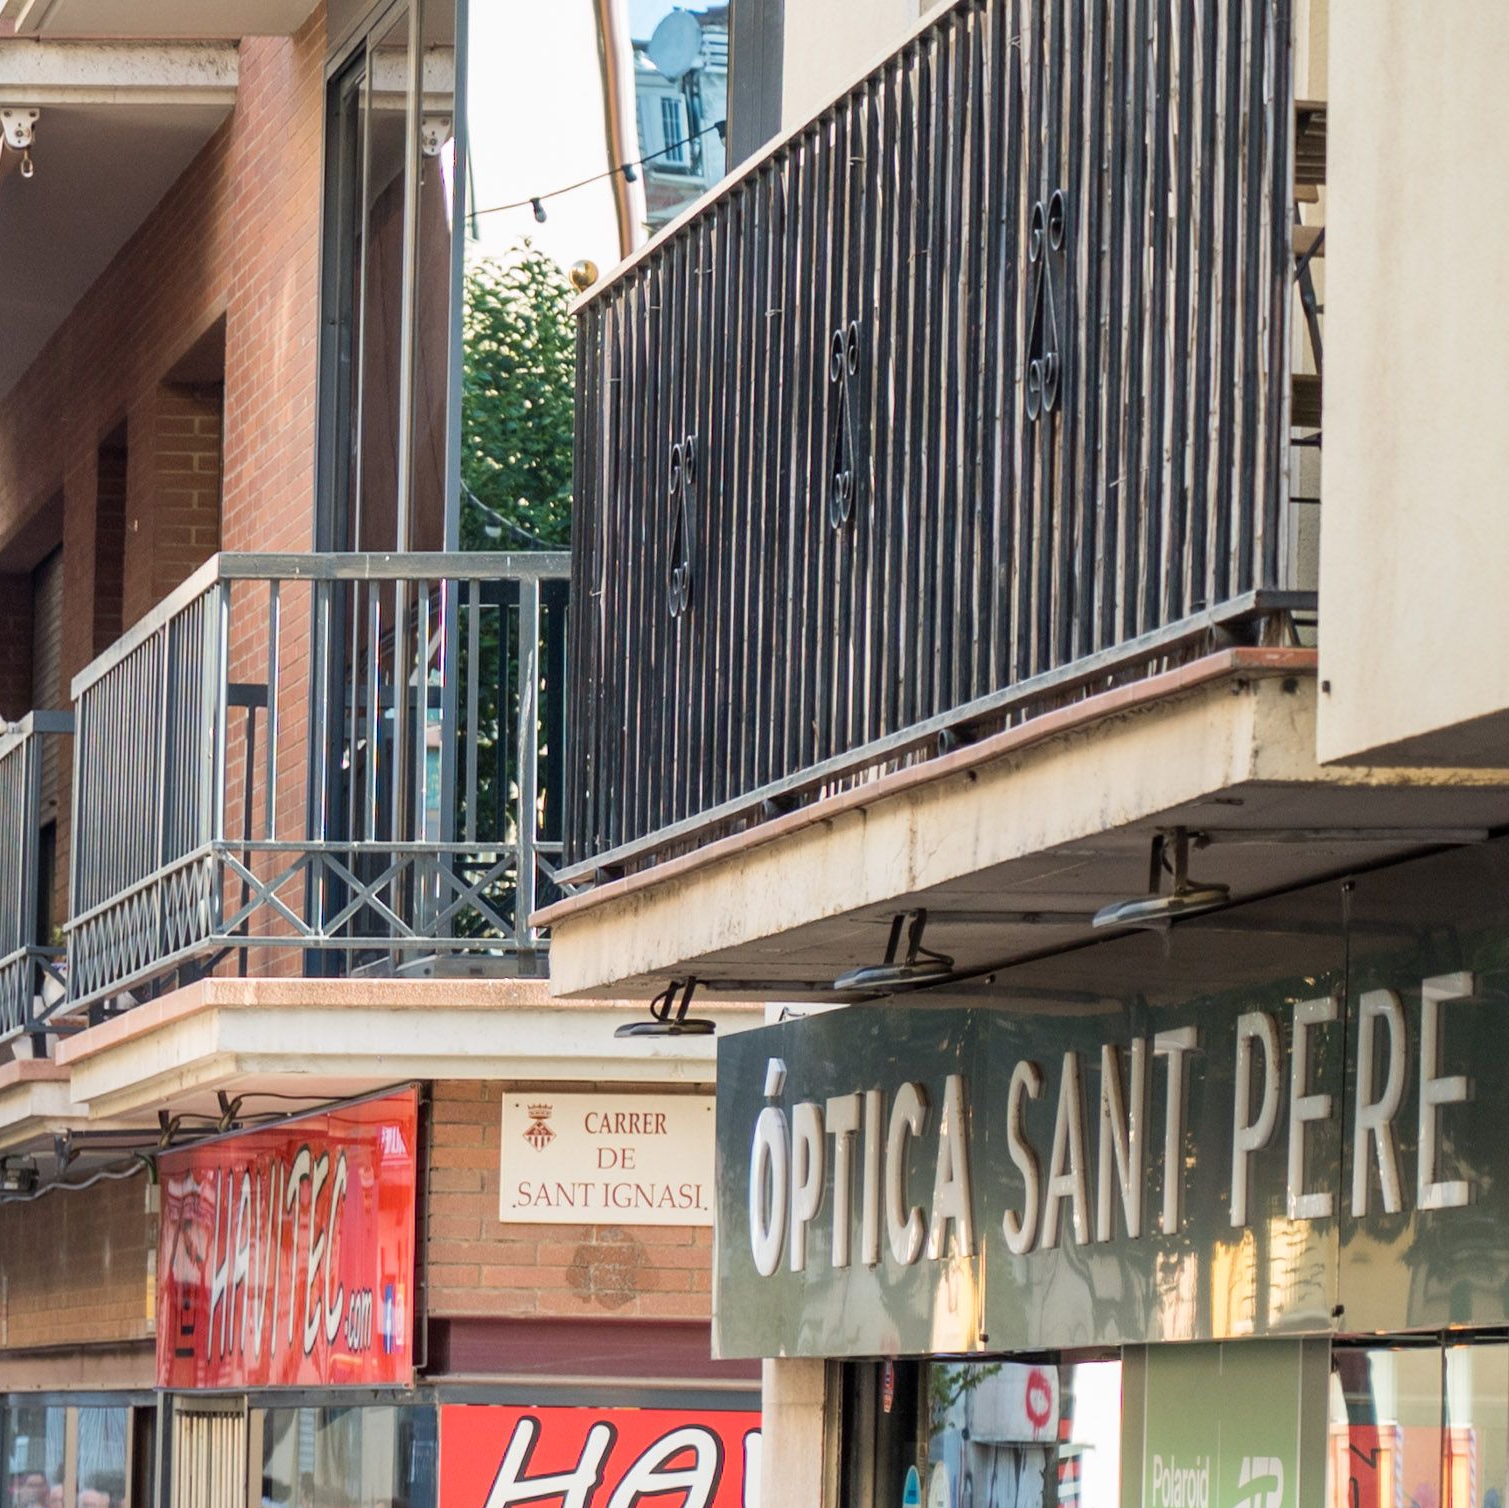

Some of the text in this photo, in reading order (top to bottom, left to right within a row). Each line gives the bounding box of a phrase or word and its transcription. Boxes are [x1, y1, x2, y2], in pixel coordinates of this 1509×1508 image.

[584, 1111, 668, 1135] CARRER
[749, 971, 1475, 1277] ÓPTICA SANT PERE
[596, 1147, 636, 1170] DE
[517, 1181, 703, 1209] SANT IGNASI
